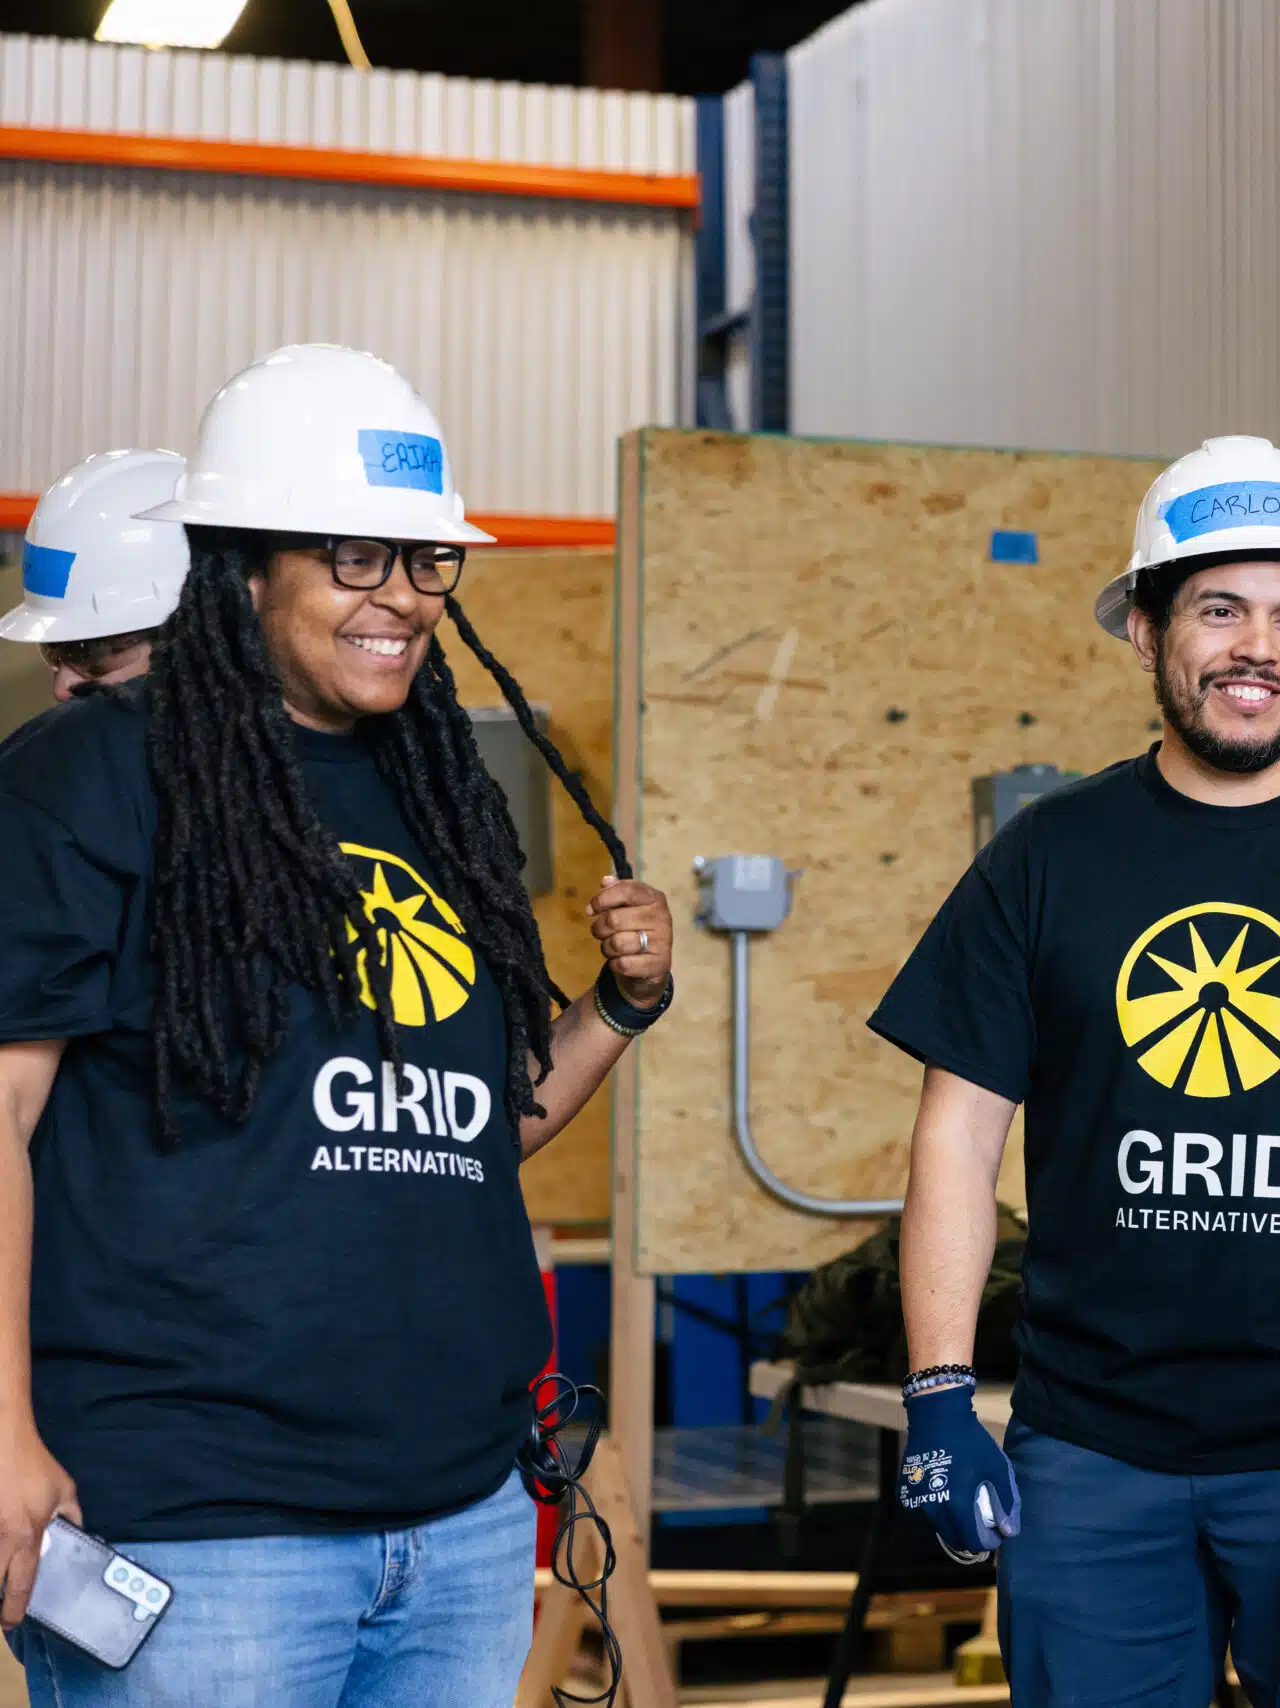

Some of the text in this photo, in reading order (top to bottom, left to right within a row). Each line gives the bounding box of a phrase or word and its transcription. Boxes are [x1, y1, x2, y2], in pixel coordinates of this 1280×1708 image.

[313, 1056, 492, 1142] GRID
[310, 1146, 485, 1183] ALTERNATIVES
[901, 1489, 950, 1508] MaxiFle
